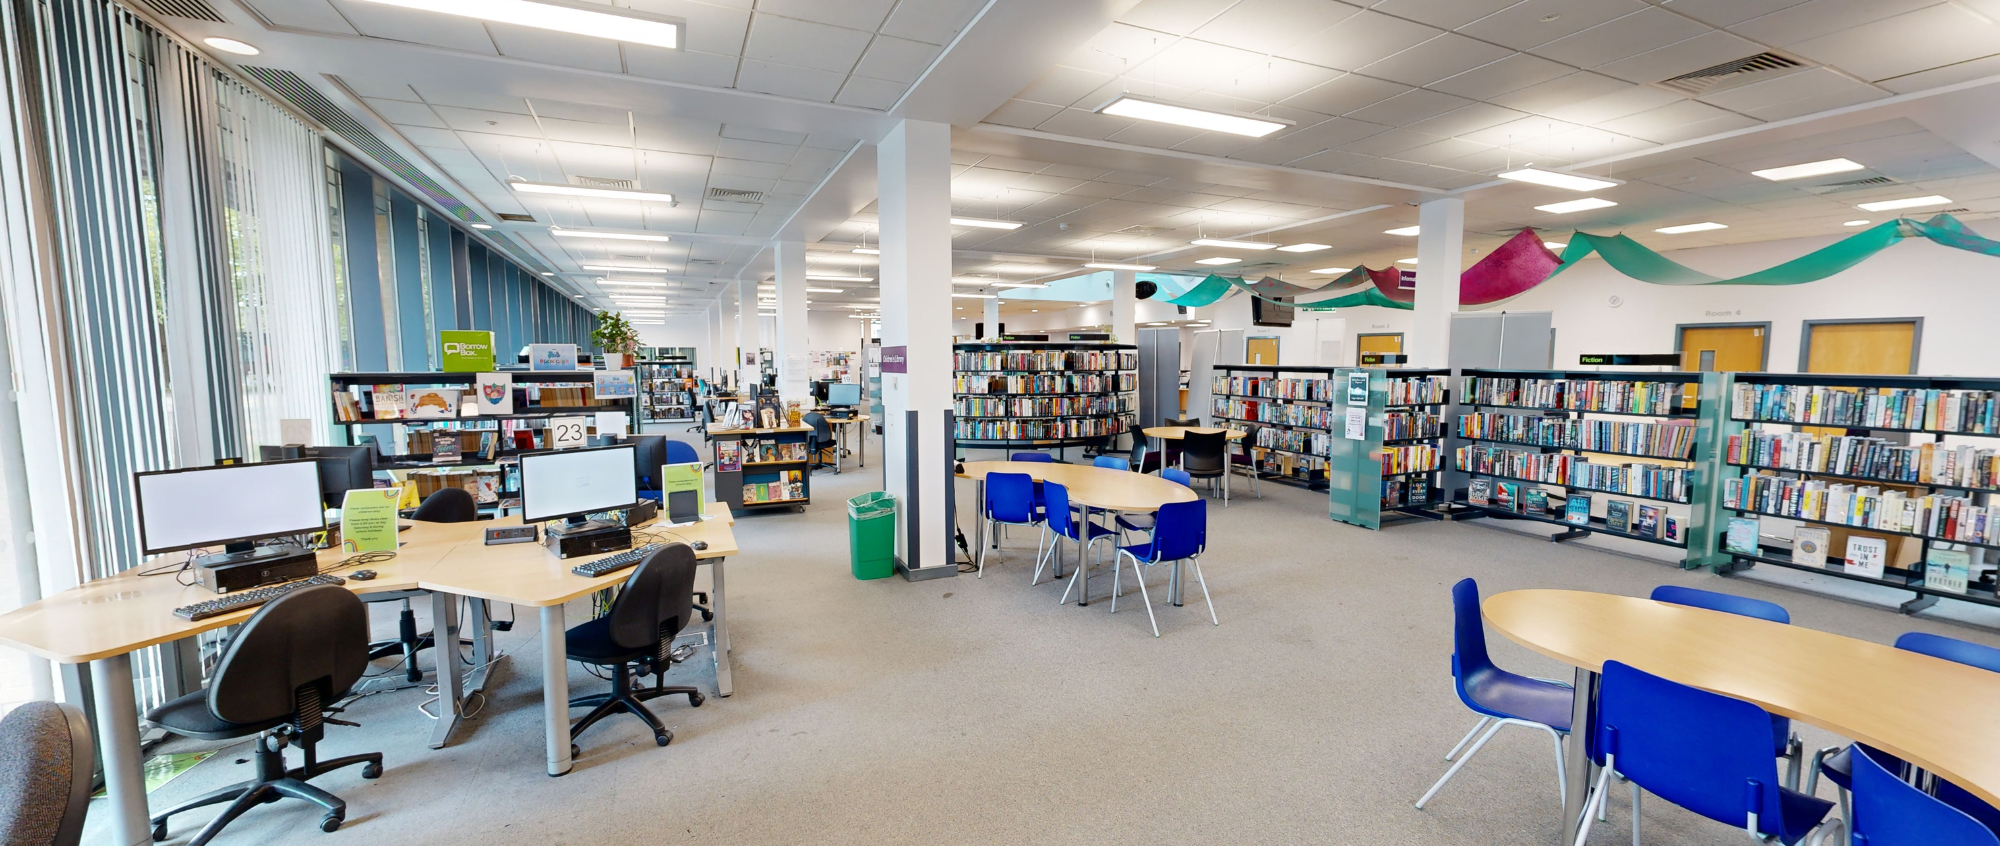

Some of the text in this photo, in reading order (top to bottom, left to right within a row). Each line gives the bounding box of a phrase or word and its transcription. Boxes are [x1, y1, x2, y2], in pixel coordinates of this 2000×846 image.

[843, 375, 850, 383] 19
[557, 424, 583, 441] 23
[1571, 498, 1588, 506] AIR
[1852, 544, 1878, 553] TRUST
